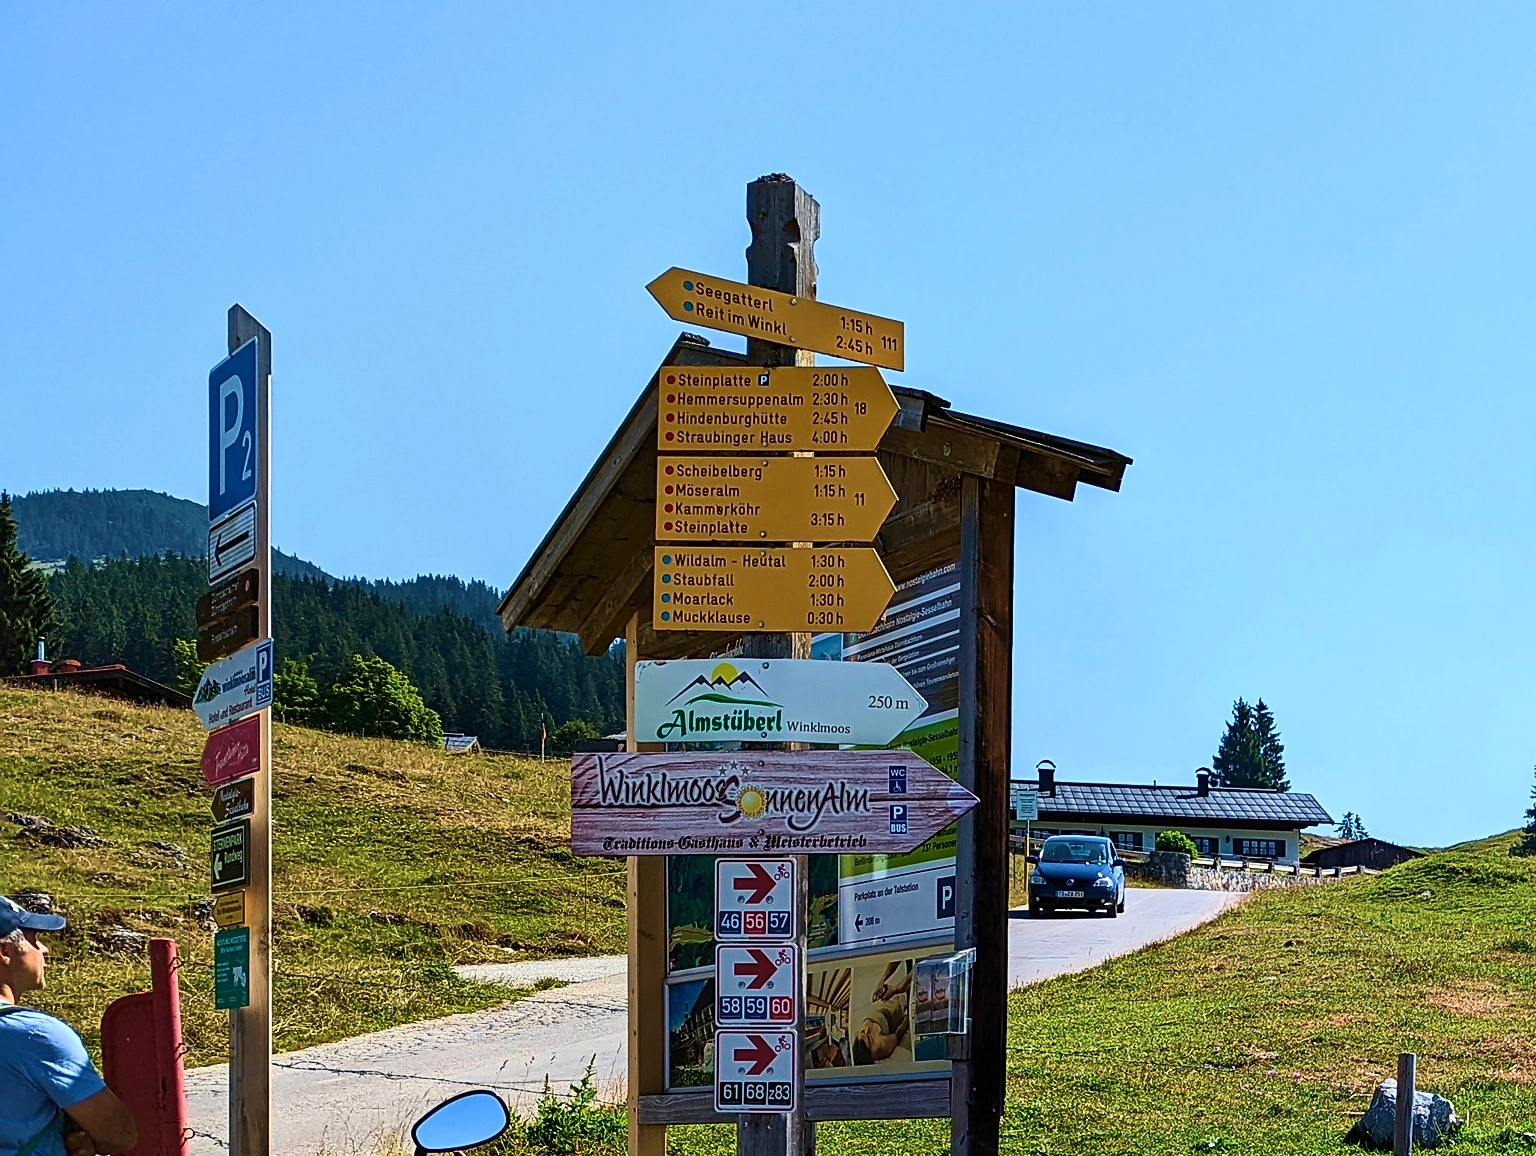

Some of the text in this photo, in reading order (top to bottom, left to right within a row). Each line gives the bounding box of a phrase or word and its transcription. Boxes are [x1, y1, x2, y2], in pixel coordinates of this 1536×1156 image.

[696, 282, 773, 312] Seegatterl
[696, 302, 786, 336] Reit im Winkl
[840, 316, 873, 335] 1:15 h
[836, 336, 873, 355] 2:45 h
[881, 336, 897, 351] 111
[678, 374, 751, 388] Steinplatte
[812, 374, 837, 387] 2:00
[841, 374, 848, 387] h
[677, 393, 848, 408] Hemmersuppenalm 2:30 h
[854, 402, 867, 415] 18
[677, 412, 848, 428] Hindenburghütte 2:45 h
[677, 431, 848, 447] Straubinger Haus 4:00 h
[677, 465, 846, 480] Scheibelberg 1:15 h
[676, 484, 845, 497] Möseralm 1:15 h
[854, 493, 865, 506] 11
[676, 503, 761, 516] Kammerköhr
[811, 513, 845, 526] 3:15 h
[675, 520, 748, 536] Steinplatte
[675, 554, 726, 568] Wildalm
[743, 555, 786, 568] Heutal
[811, 555, 835, 568] 1:30
[837, 555, 845, 568] h
[673, 574, 844, 588] Staubfall 2:00 h
[673, 593, 844, 607] Moarlack 1:30 h
[673, 611, 843, 625] Muckklause 0:30 h
[259, 651, 268, 682] P
[258, 685, 270, 700] BUS
[868, 695, 909, 709] 250 m
[657, 709, 783, 738] Almstüberl
[787, 720, 850, 734] Winklmoos
[890, 768, 906, 778] WC
[892, 806, 904, 820] P
[890, 823, 907, 834] BUS
[603, 834, 868, 852] Traditions-Gasthaus & Meisterbetrieb
[854, 890, 876, 901] Parkplatz
[885, 887, 893, 896] der
[893, 883, 919, 894] Talstation
[942, 885, 953, 910] P
[721, 913, 789, 929] 46 56 57
[722, 998, 790, 1014] 58 59 60
[723, 1084, 790, 1100] 61 68 z83
